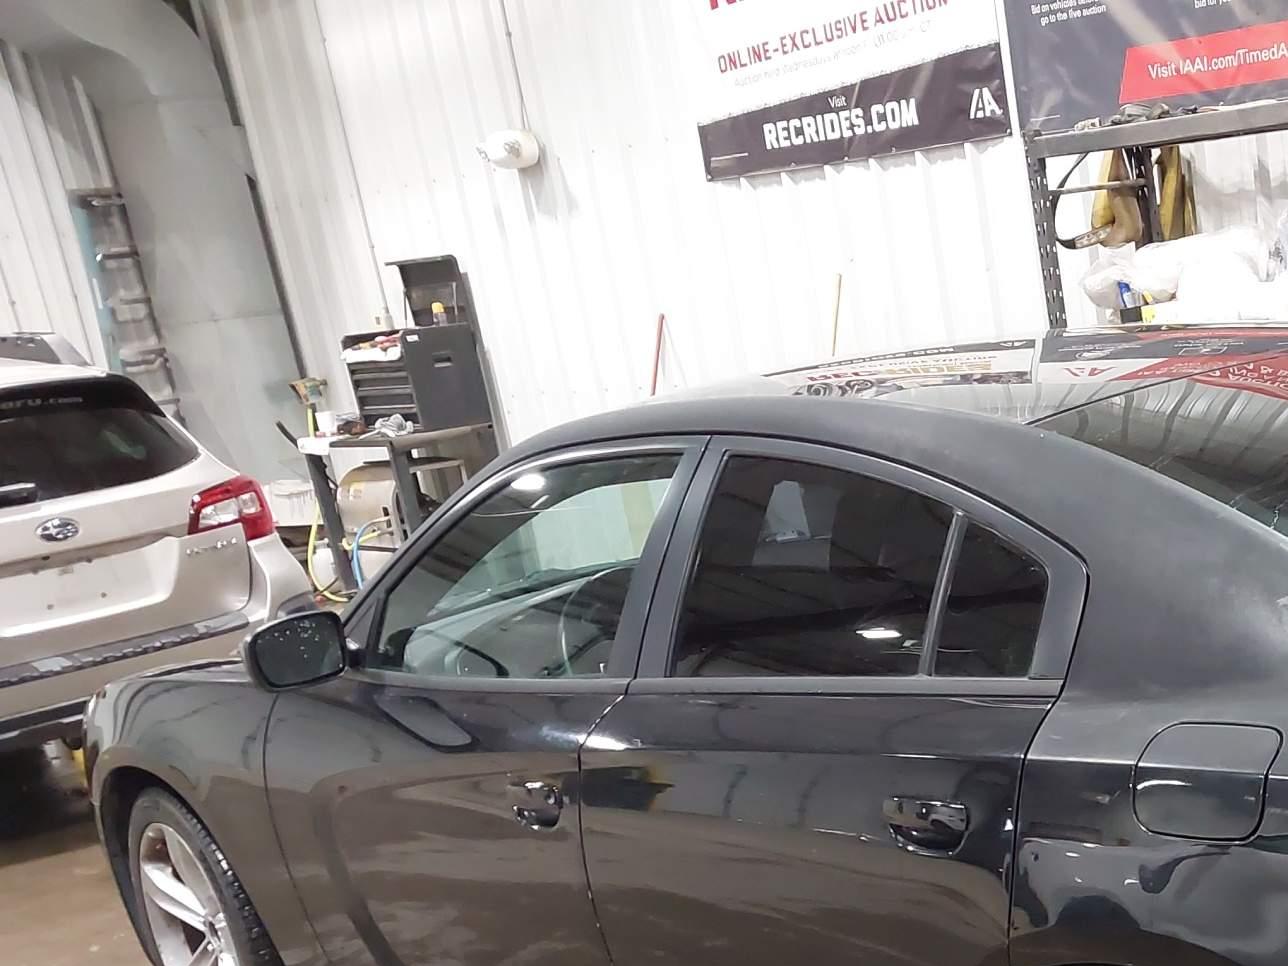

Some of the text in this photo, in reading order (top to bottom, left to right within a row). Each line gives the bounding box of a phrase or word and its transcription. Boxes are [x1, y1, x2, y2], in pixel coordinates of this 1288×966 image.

[717, 11, 869, 73] ONLINE-EXCLUSIVE
[1148, 61, 1177, 79] Visit
[828, 95, 847, 109] Visit
[762, 98, 919, 149] RECRIDES.COM
